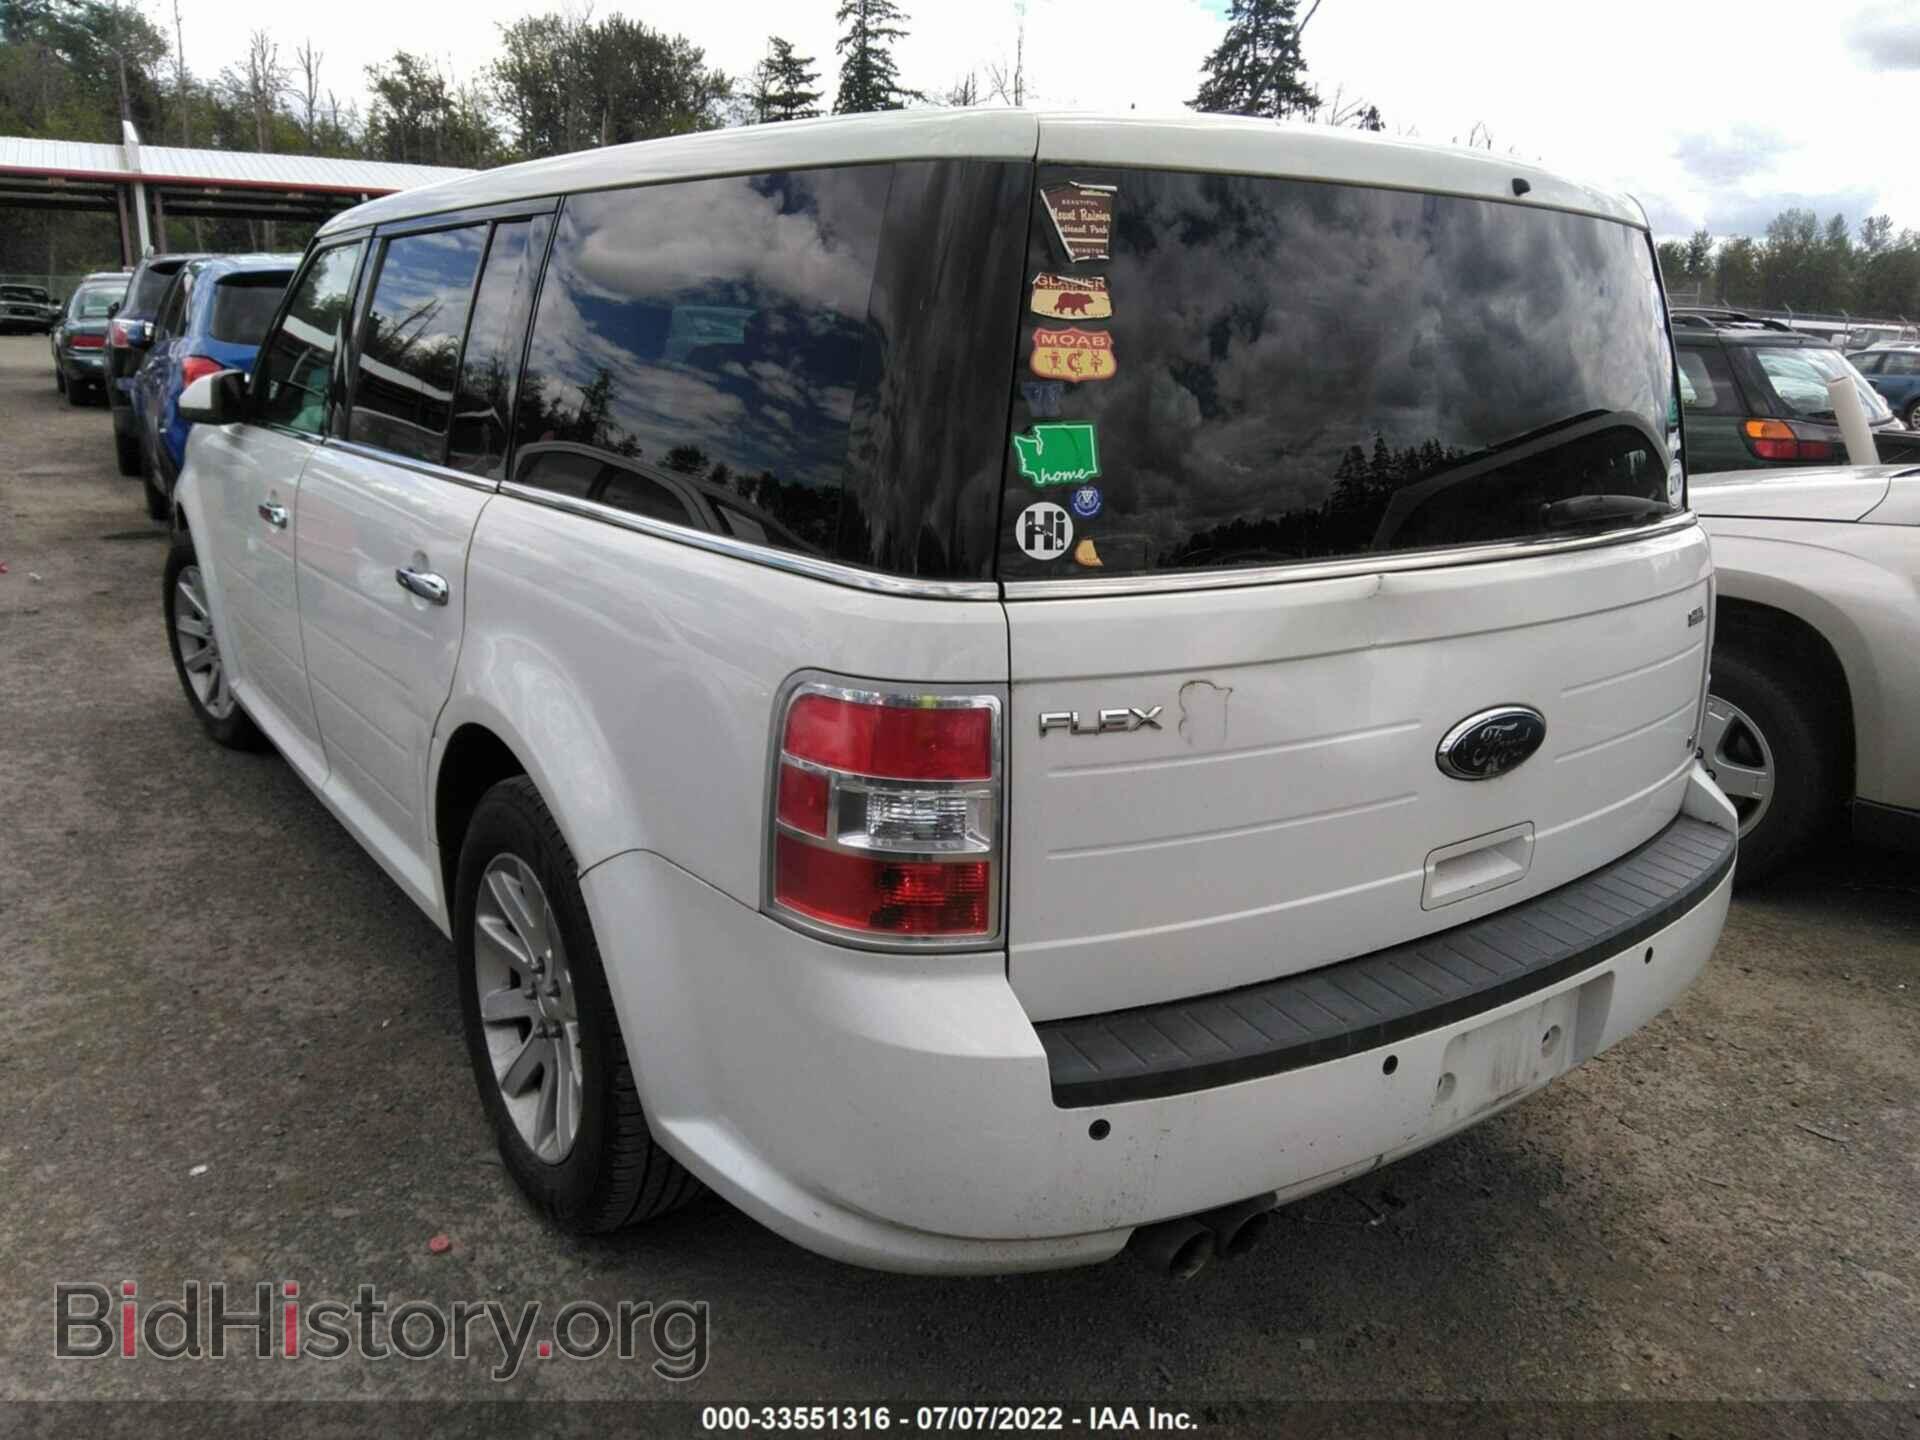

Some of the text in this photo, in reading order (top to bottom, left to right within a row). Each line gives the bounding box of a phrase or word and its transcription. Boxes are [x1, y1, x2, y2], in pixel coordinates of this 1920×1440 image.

[1041, 334, 1106, 347] MOAB
[1041, 468, 1087, 482] home
[1025, 511, 1065, 550] Hi
[1039, 705, 1163, 738] FLEX
